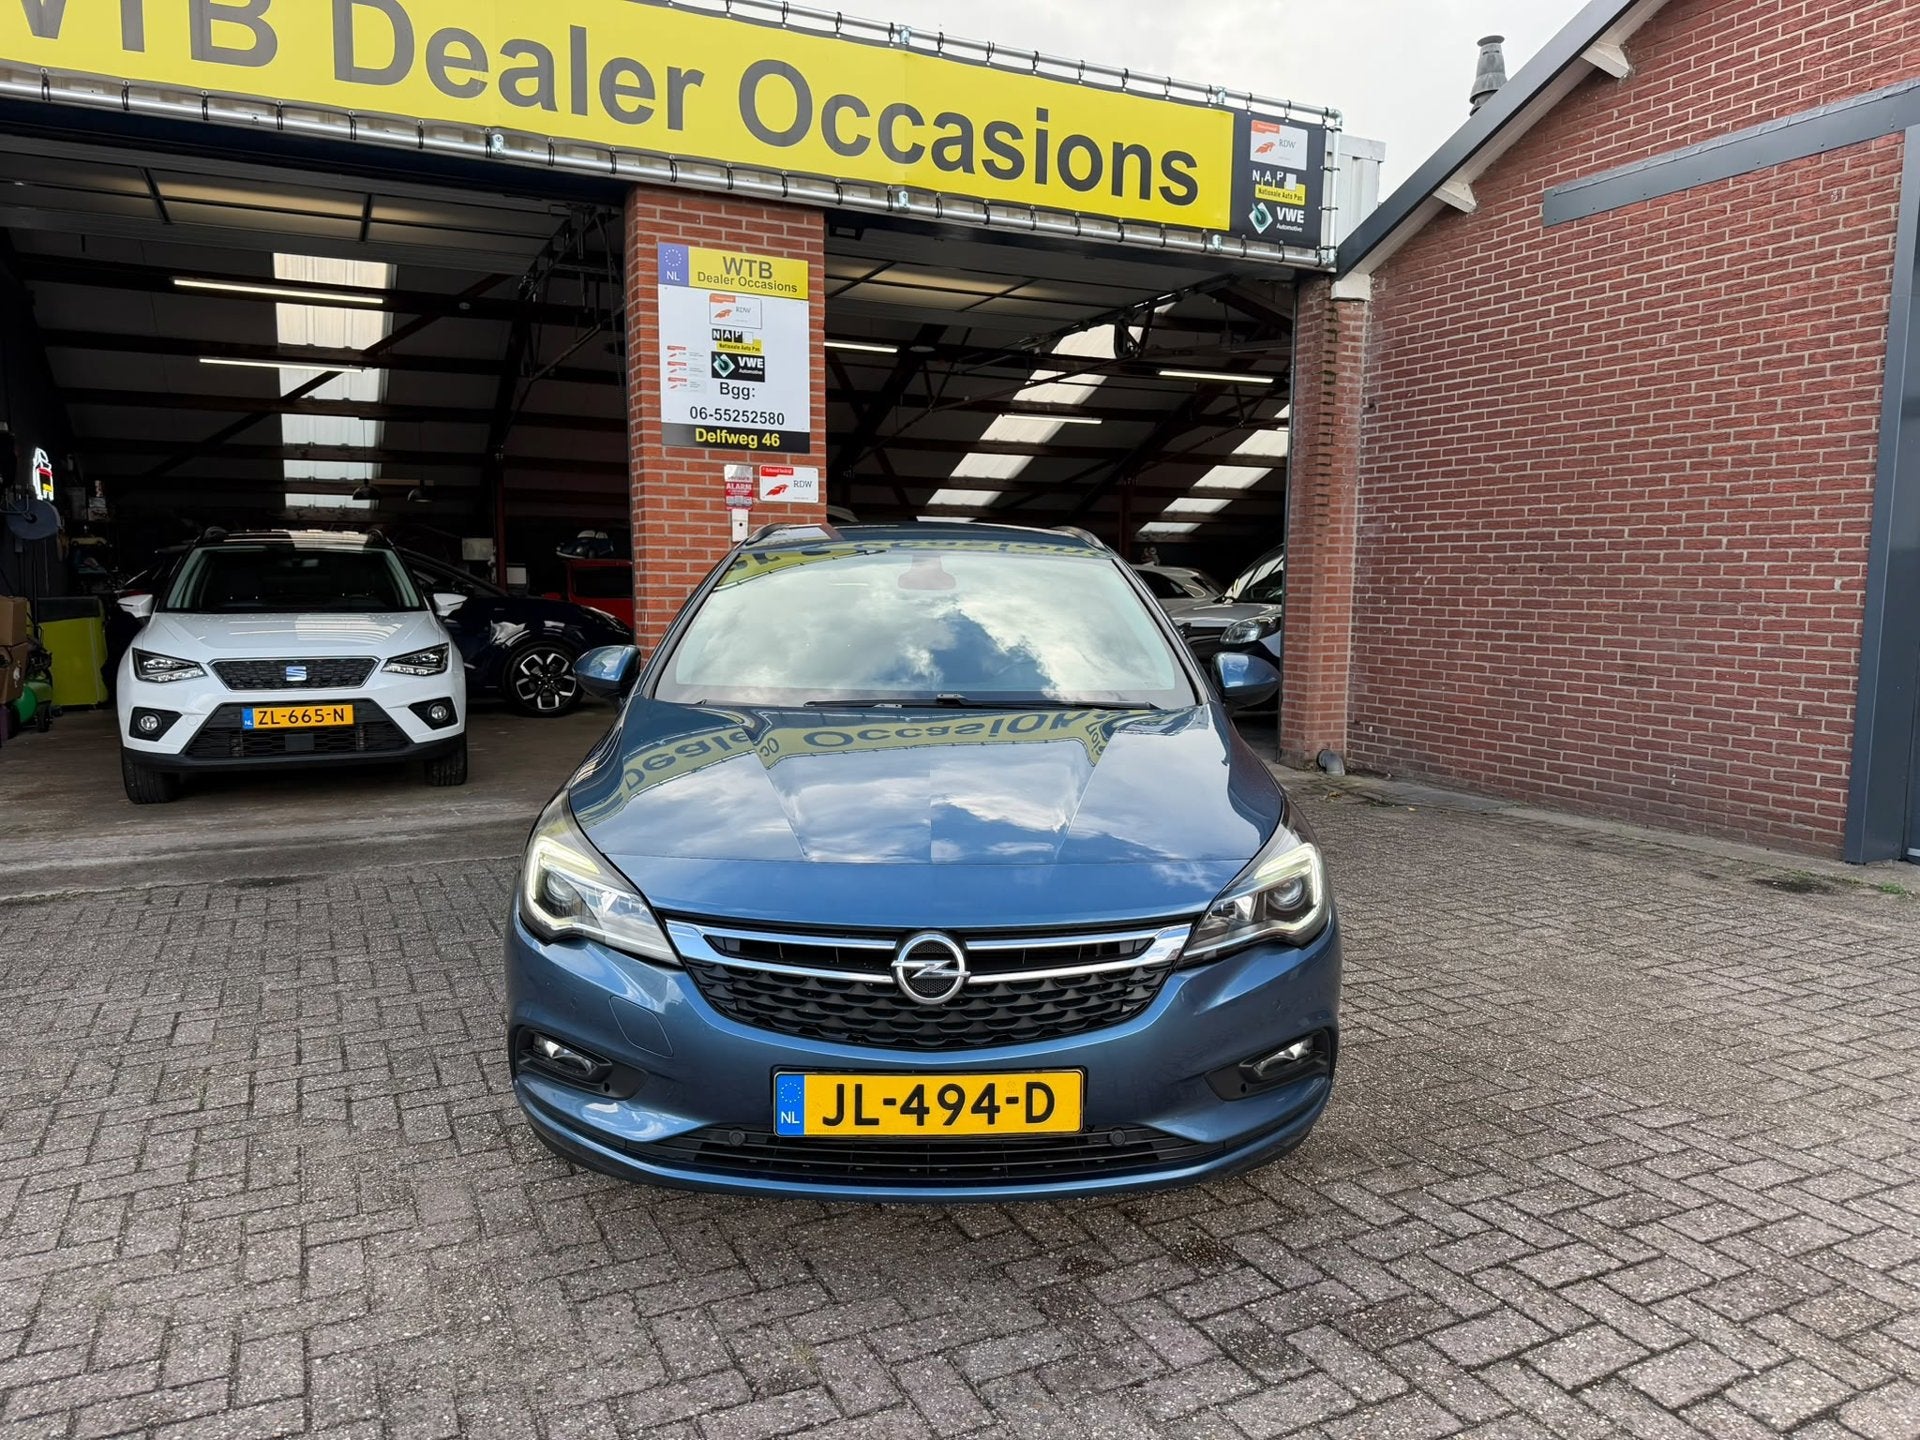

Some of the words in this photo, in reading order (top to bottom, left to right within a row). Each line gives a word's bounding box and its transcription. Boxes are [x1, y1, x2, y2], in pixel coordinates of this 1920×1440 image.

[332, 0, 705, 132] Dealer
[738, 58, 1200, 207] Occasions
[1278, 138, 1297, 149] RDW
[1276, 206, 1305, 223] VWE
[1276, 223, 1303, 233] Automotive
[666, 270, 681, 282] NL
[722, 256, 774, 280] WTB
[697, 271, 735, 286] Dealer
[738, 276, 798, 293] Occasions
[737, 356, 764, 369] VWE
[719, 381, 756, 400] Bgg:
[689, 405, 785, 426] 06-55252580
[695, 427, 758, 449] Delfweg
[761, 432, 780, 447] 46
[726, 482, 752, 491] ALARM
[793, 480, 813, 488] RDW
[258, 707, 345, 726] ZL-665-N
[822, 1081, 1056, 1127] JL-494-D
[780, 1111, 800, 1124] NL
